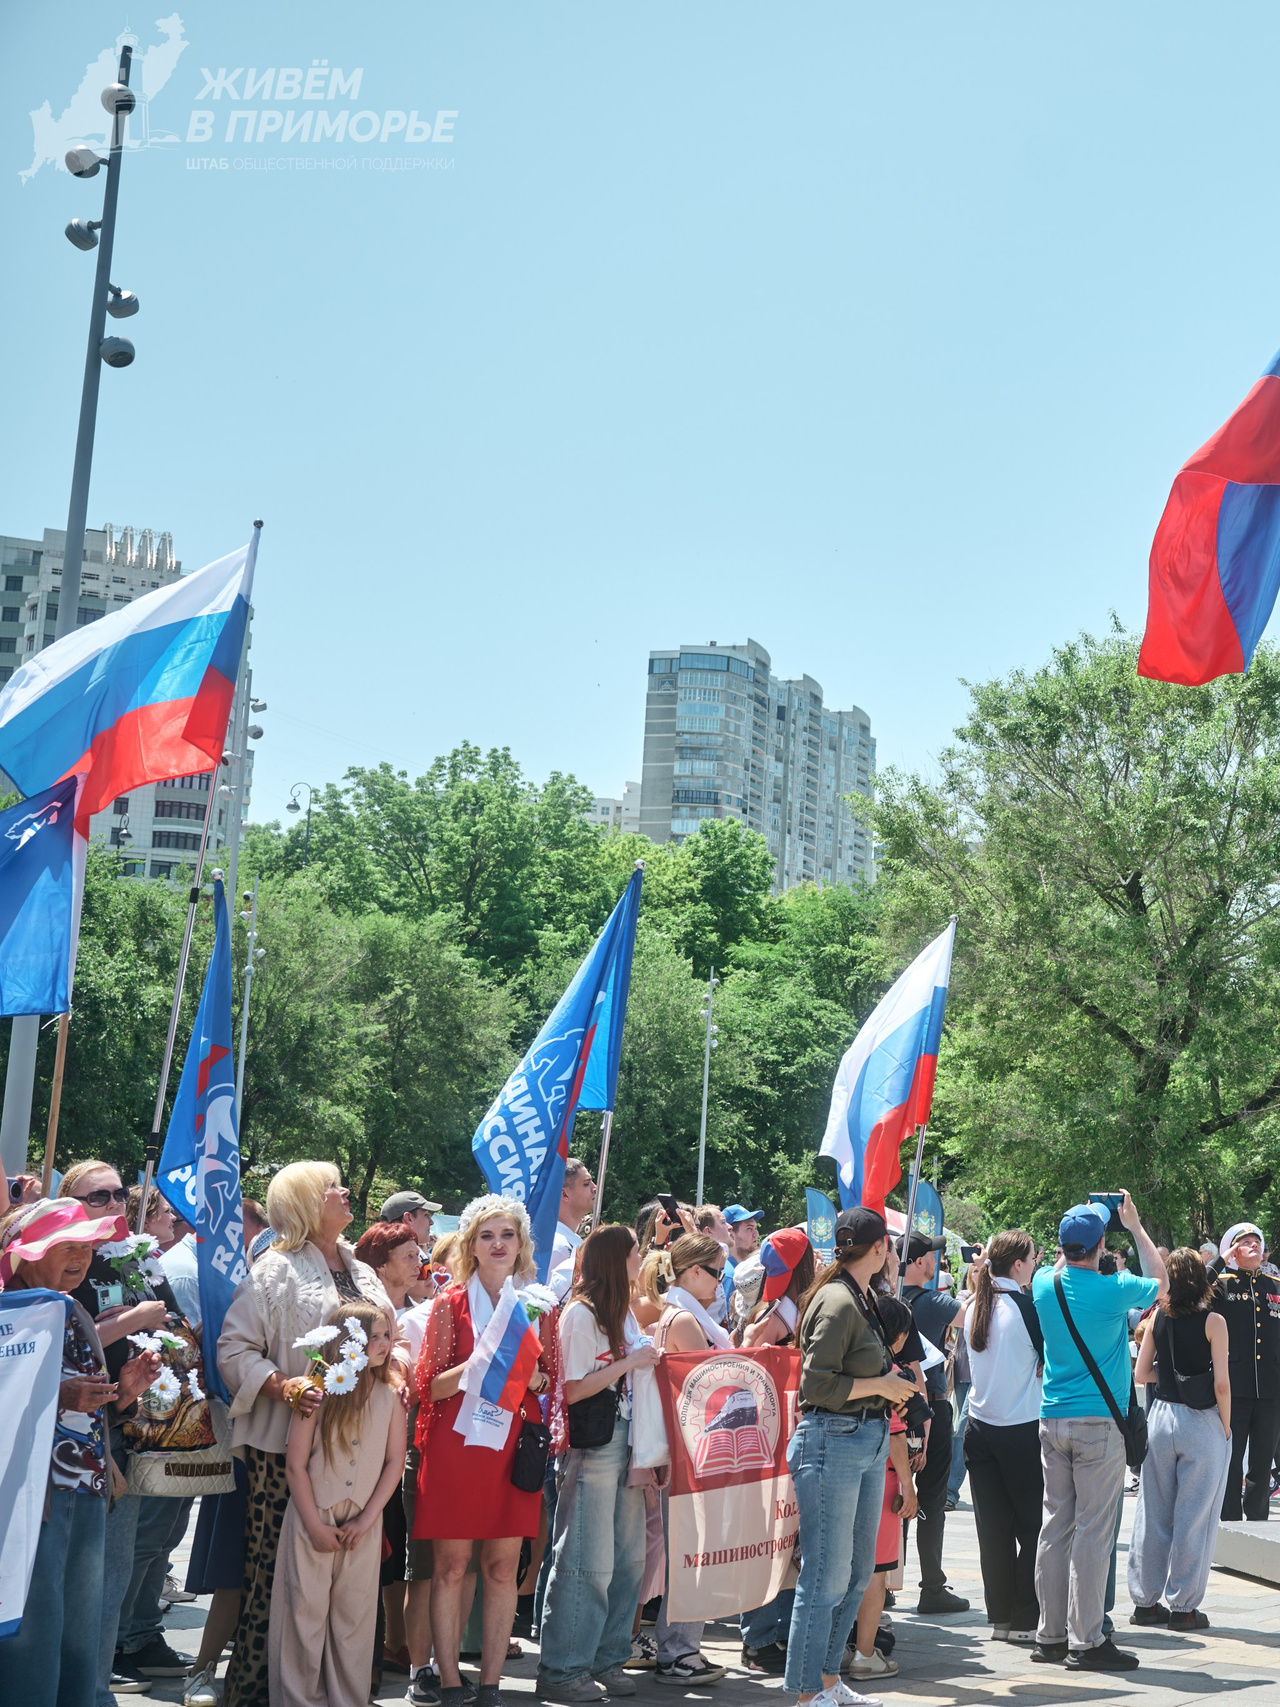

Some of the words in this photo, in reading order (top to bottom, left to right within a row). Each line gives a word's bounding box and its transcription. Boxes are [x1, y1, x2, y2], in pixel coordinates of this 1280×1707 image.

[503, 1064, 548, 1194] ДИНА
[690, 1361, 750, 1390] МАШИНОСТРОЕНИЯ
[756, 1373, 777, 1417] ТРАНСПОРТА
